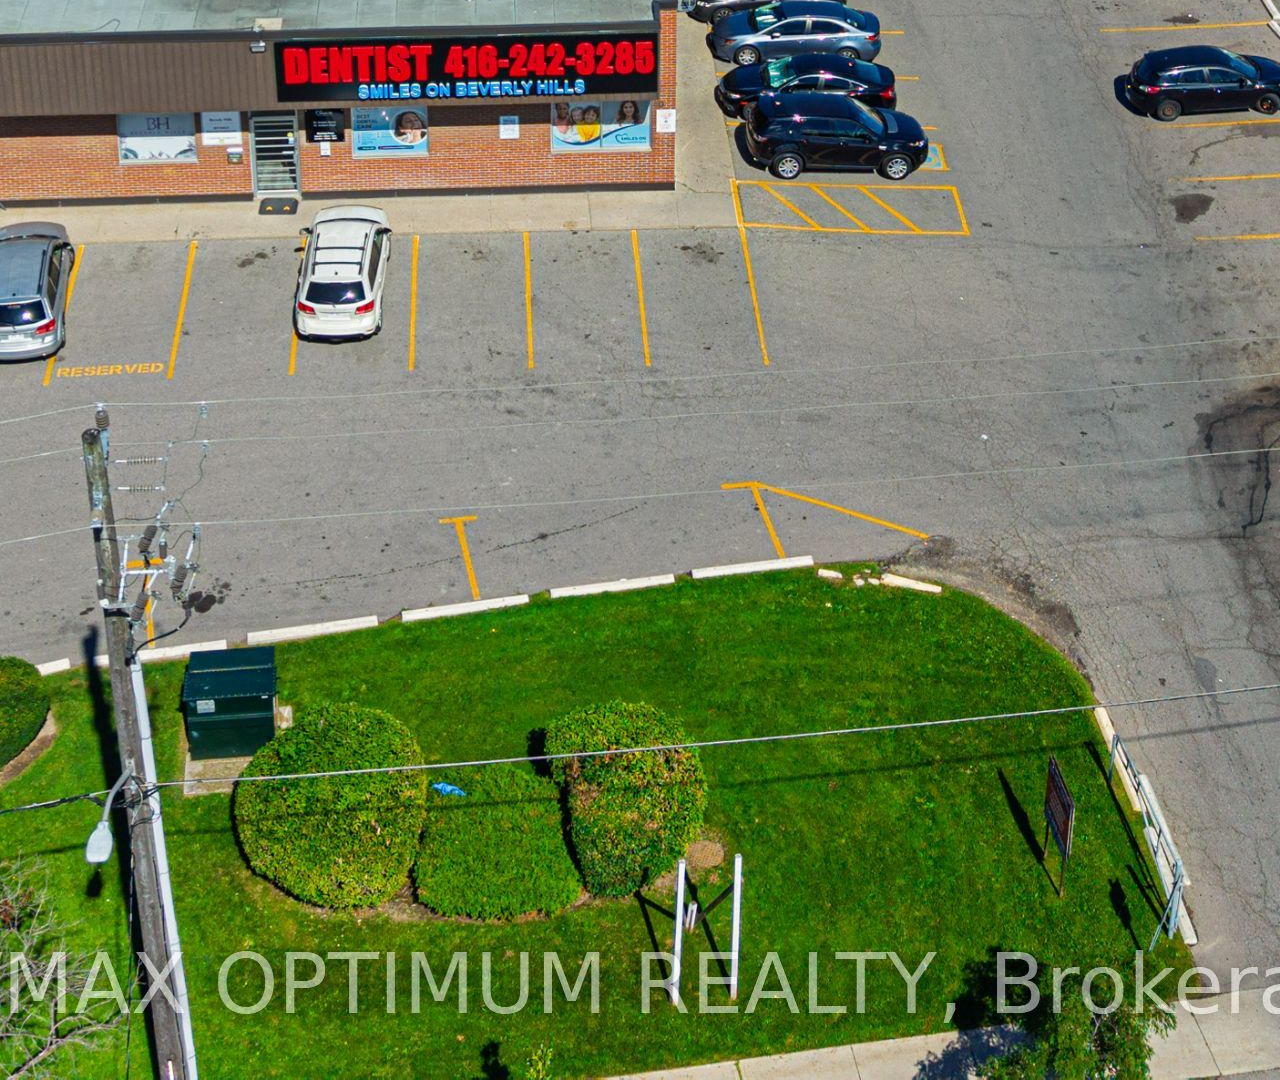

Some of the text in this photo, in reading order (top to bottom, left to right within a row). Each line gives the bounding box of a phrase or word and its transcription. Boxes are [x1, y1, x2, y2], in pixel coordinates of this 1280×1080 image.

[282, 41, 656, 85] DENTIST 416-242-3285
[357, 78, 587, 101] SMILES ON BEVERLY HILLS
[56, 361, 165, 378] RESERVED
